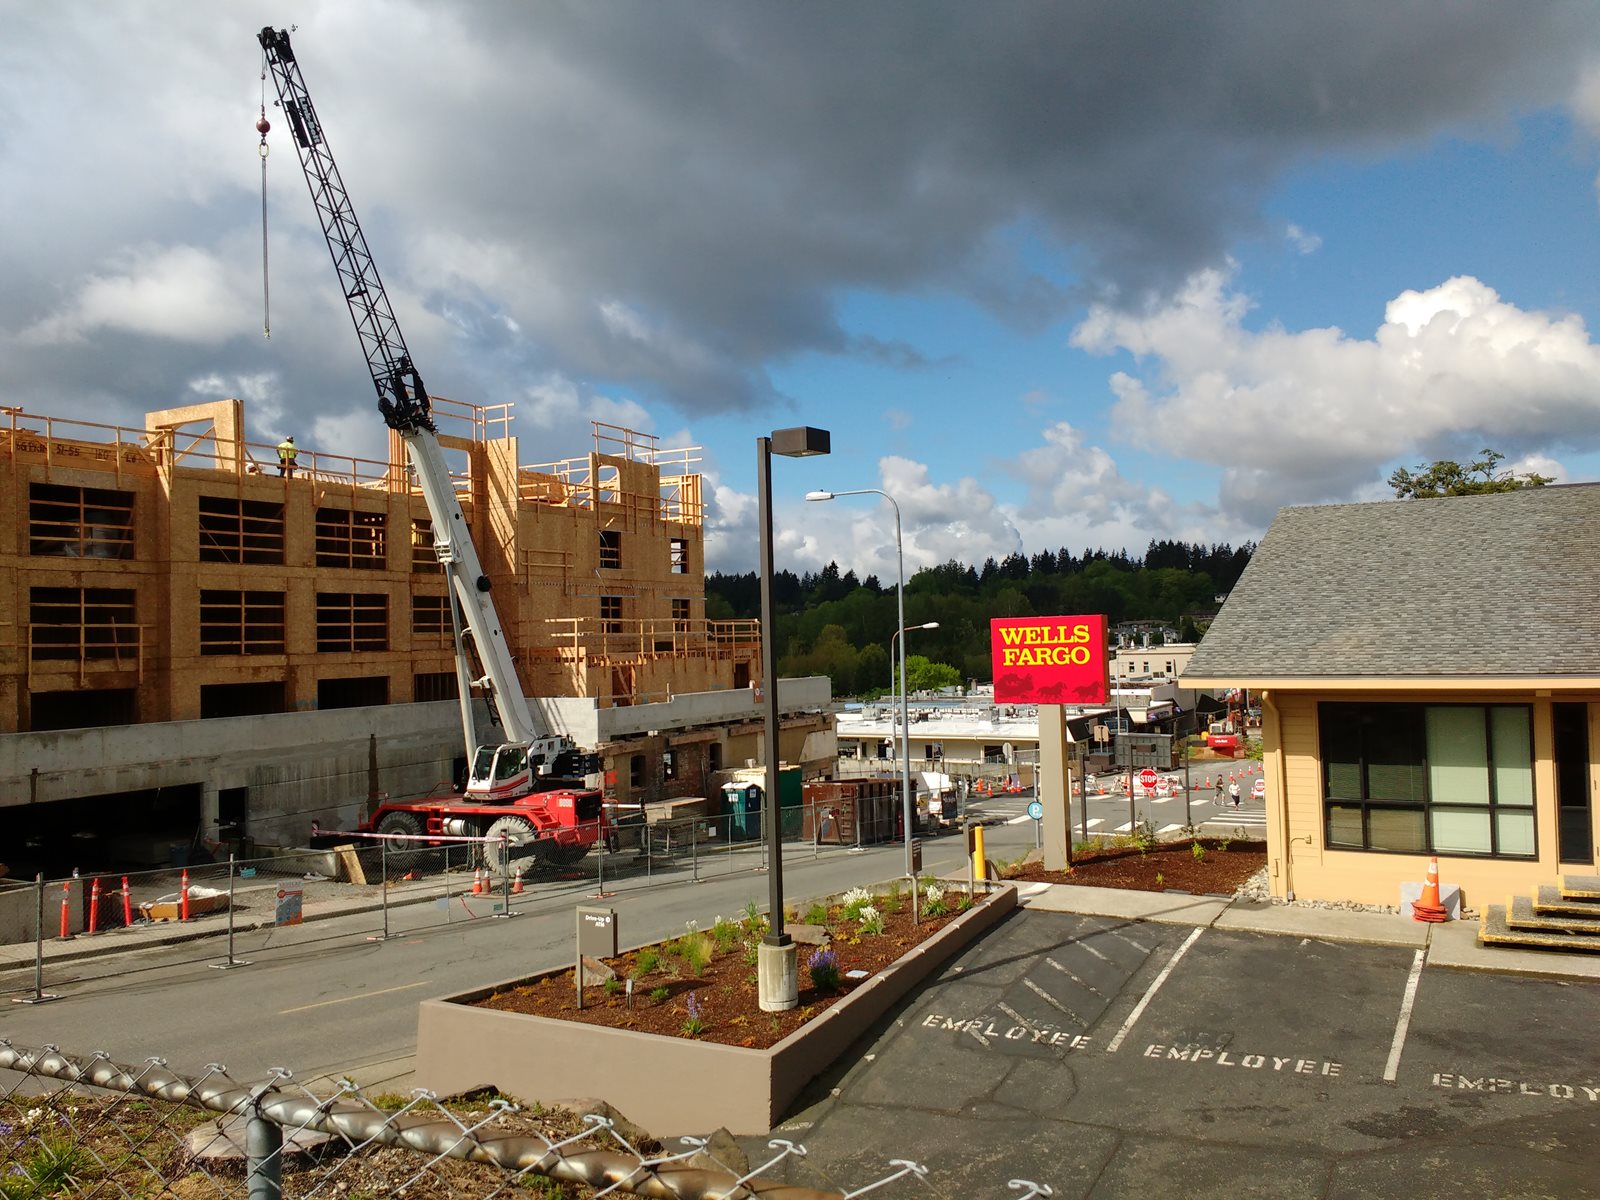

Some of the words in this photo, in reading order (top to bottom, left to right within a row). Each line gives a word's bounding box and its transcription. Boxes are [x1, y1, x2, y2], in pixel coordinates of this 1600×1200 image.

[998, 624, 1090, 645] WELLS
[1002, 645, 1091, 666] FARGO
[1140, 775, 1157, 783] STOP
[921, 1014, 1092, 1049] EMPLOYEE
[1143, 1044, 1343, 1077] EMPLOYEE
